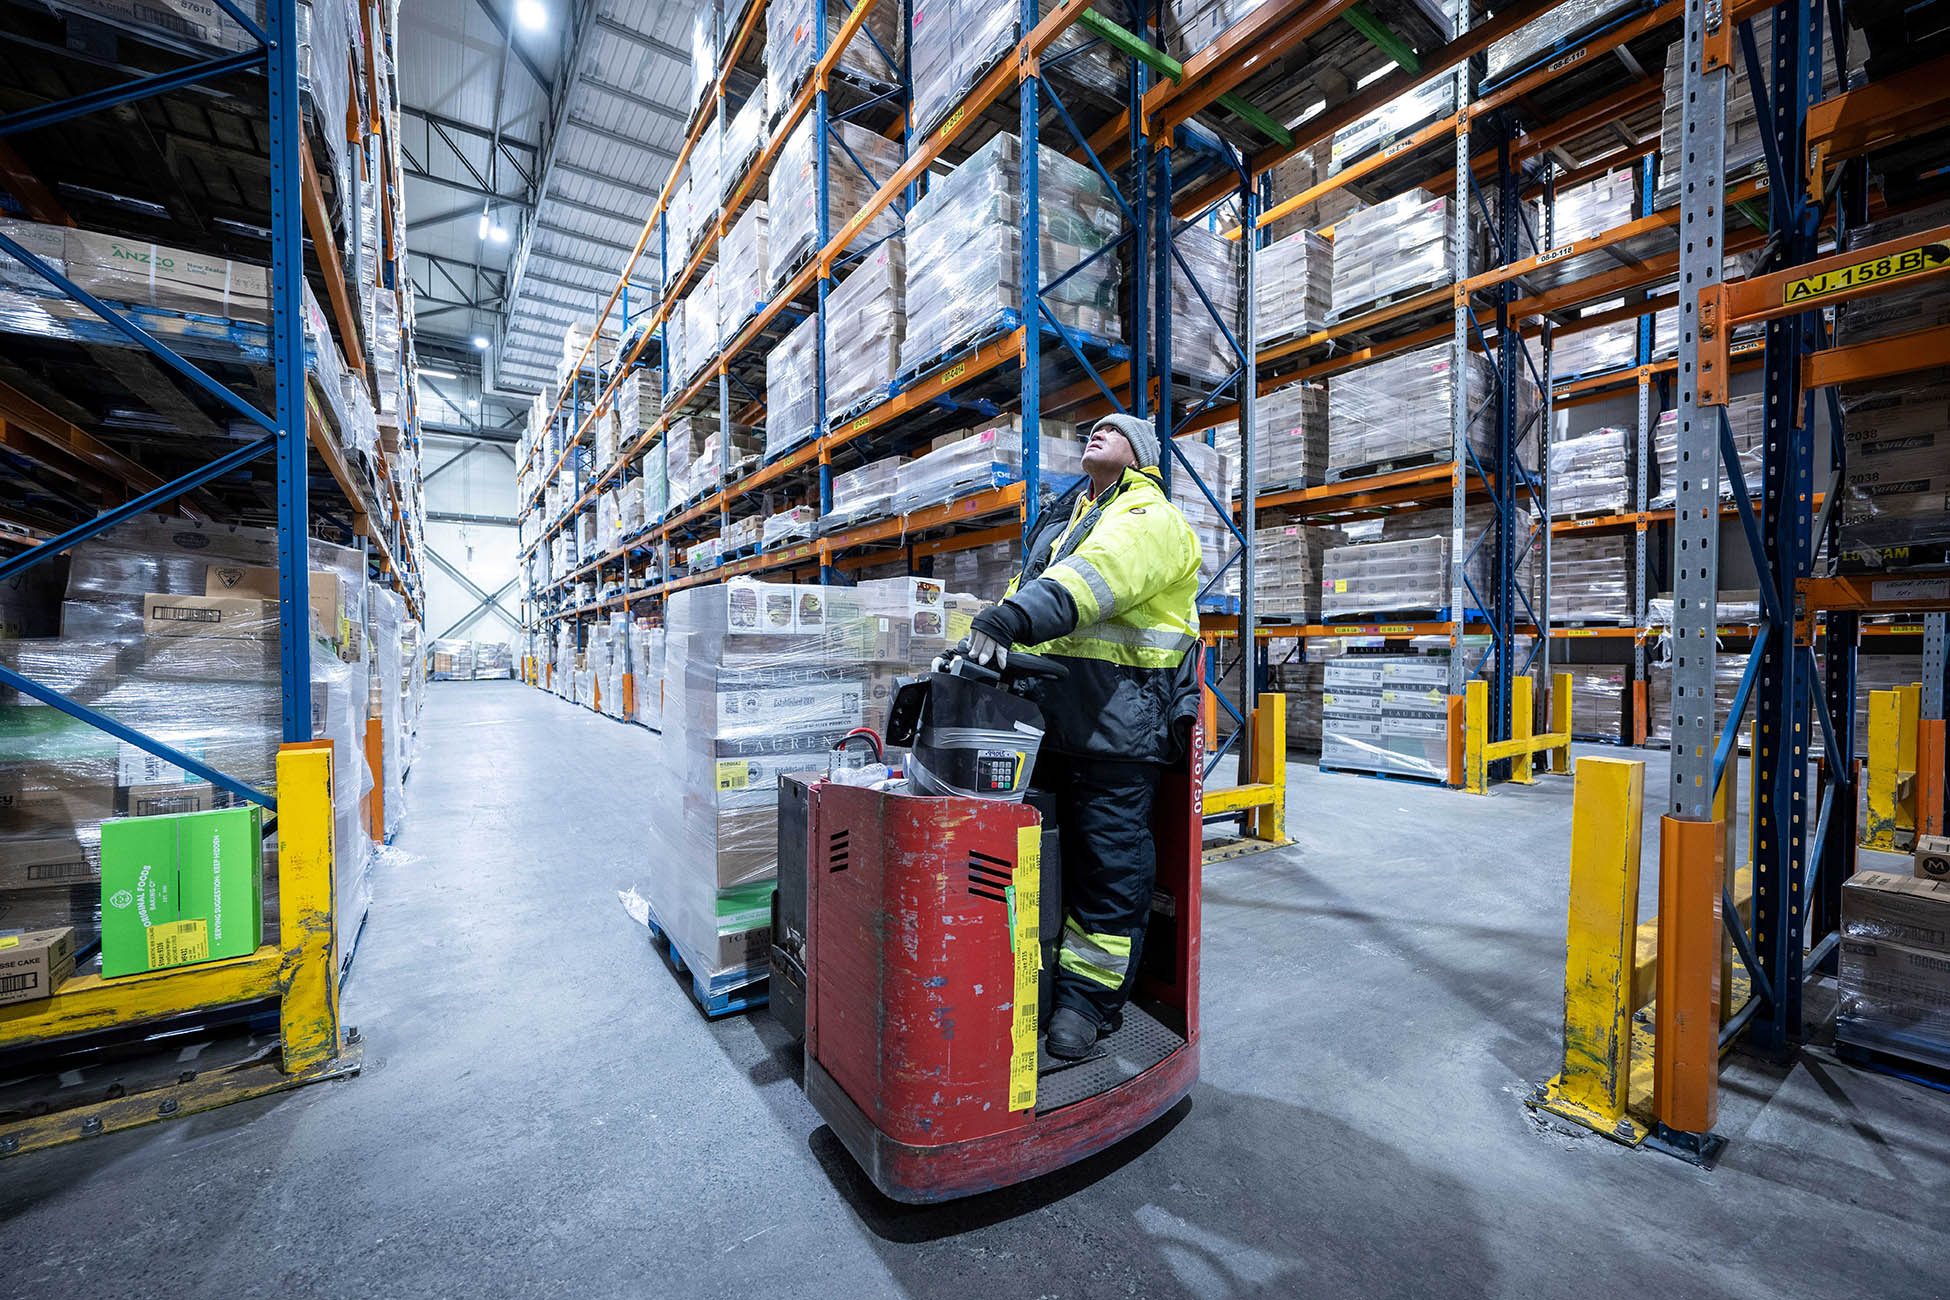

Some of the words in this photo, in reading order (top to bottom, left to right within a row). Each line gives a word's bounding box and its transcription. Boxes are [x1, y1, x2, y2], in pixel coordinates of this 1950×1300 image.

[112, 247, 175, 268] ANZCO
[1791, 252, 1921, 299] AJ.158.B
[1847, 429, 1878, 441] 2038
[1849, 471, 1880, 484] 2038
[1842, 547, 1909, 561] LOAM
[737, 669, 847, 683] LAURENT
[1388, 711, 1439, 719] LAURENT
[136, 865, 152, 892] FOODS
[136, 893, 152, 928] ORIGINAL
[17, 958, 40, 967] CAKE
